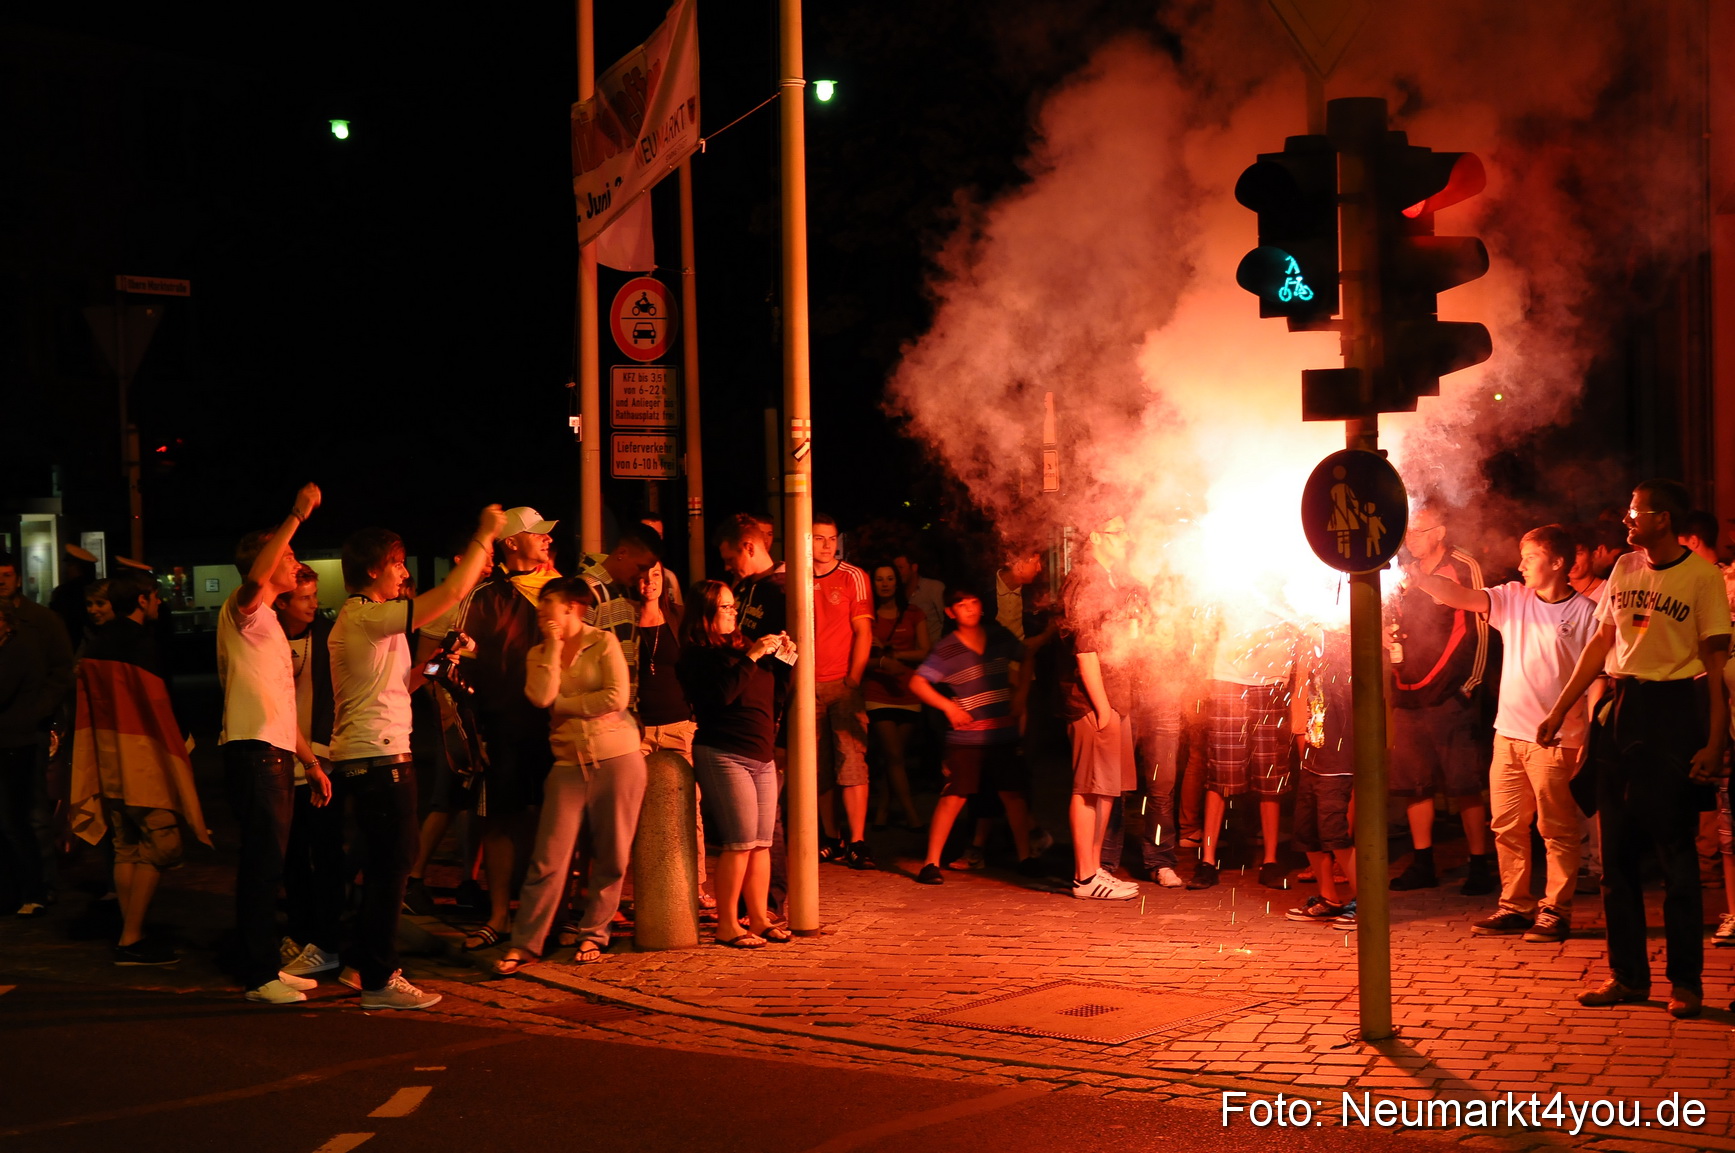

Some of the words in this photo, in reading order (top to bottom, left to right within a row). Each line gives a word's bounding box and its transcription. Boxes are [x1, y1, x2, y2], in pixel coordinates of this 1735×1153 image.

[587, 183, 611, 219] Juni
[623, 373, 636, 383] KFZ
[639, 373, 648, 383] bis
[624, 386, 636, 395] von
[639, 386, 660, 395] 6-22
[662, 385, 667, 394] h
[616, 398, 629, 407] und
[632, 398, 660, 409] Anlieger
[664, 398, 674, 407] bis
[616, 410, 660, 422] Rathausplatz
[663, 410, 675, 420] frei
[617, 442, 673, 453] Lieferverkehr
[616, 461, 630, 470] von
[660, 458, 675, 470] frei
